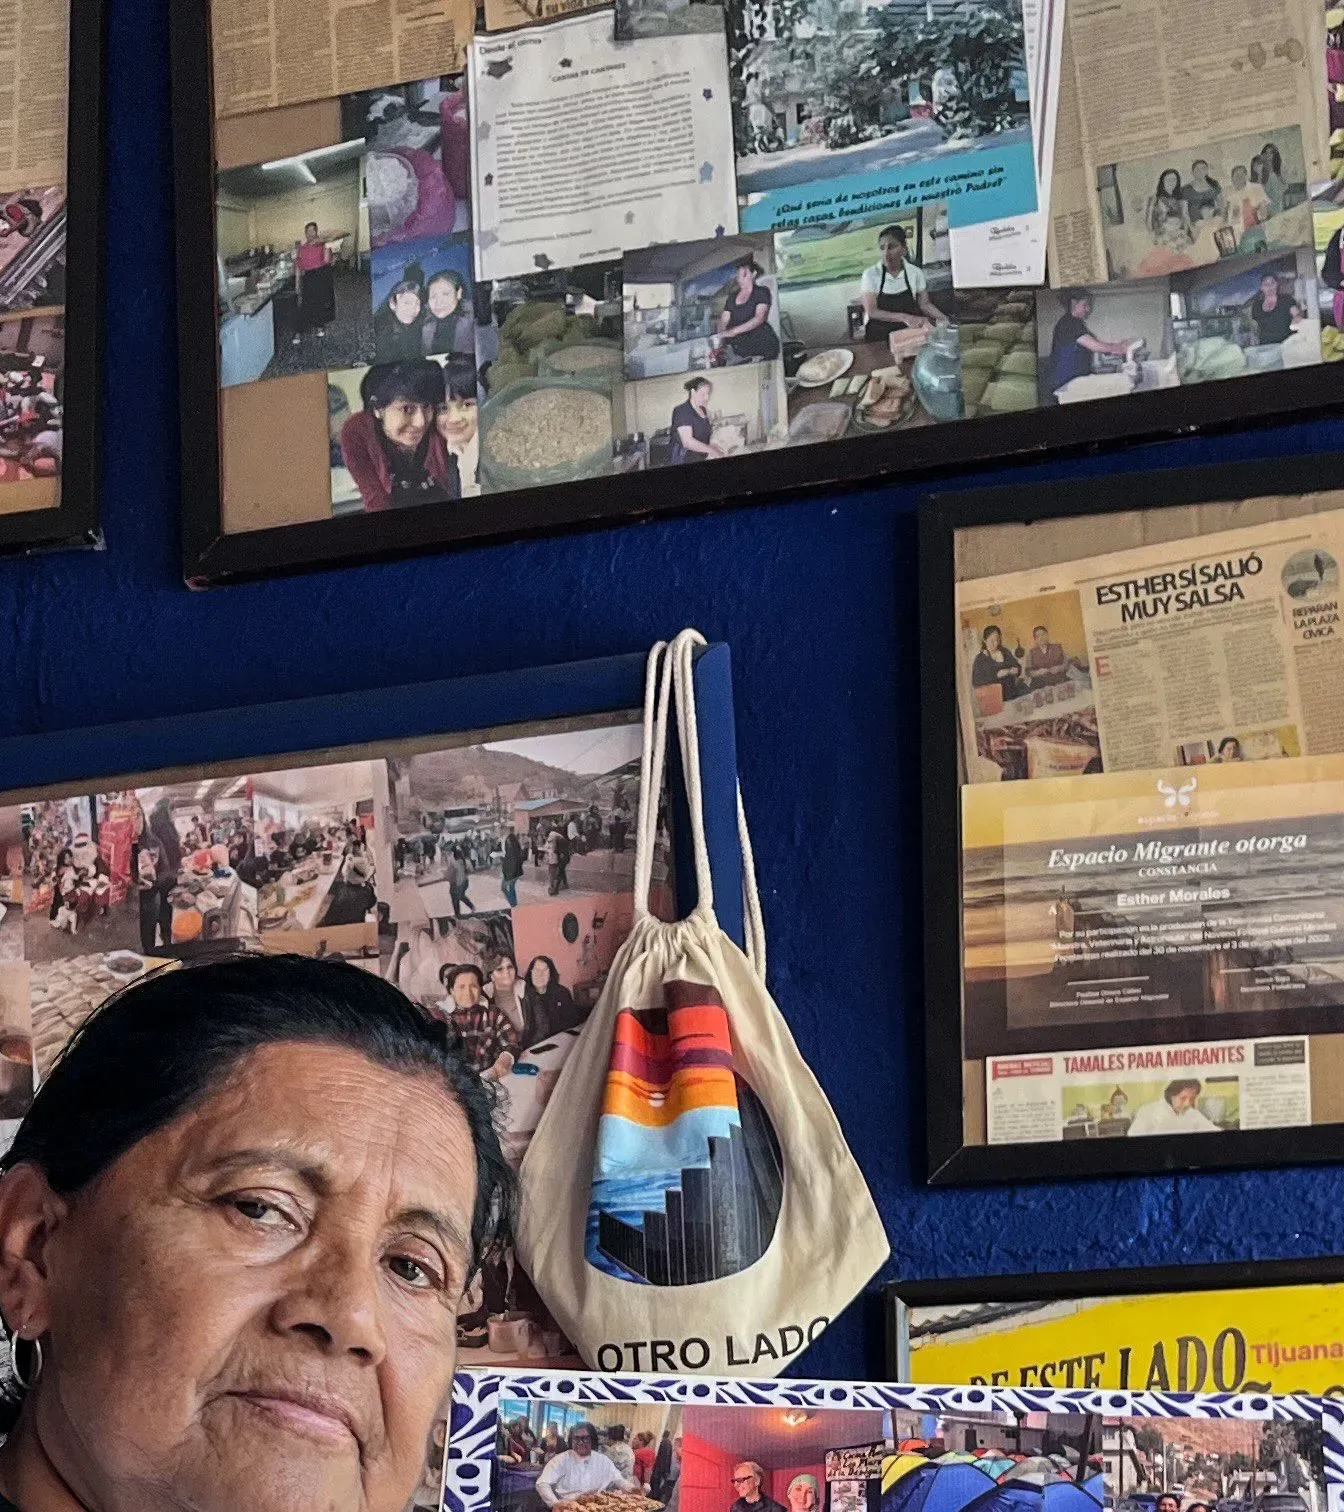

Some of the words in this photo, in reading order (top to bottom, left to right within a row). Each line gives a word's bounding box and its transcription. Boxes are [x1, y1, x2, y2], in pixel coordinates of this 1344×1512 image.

[836, 192, 849, 203] de
[944, 168, 984, 184] camino
[1096, 572, 1177, 606] ESTHER
[1177, 563, 1199, 588] SÍ
[1199, 551, 1264, 585] SALIÓ
[1120, 594, 1173, 624] MUY
[1175, 583, 1246, 613] SALSA
[1292, 601, 1339, 619] REPARAN
[1293, 616, 1307, 630] LA
[1047, 845, 1128, 871] Espacio
[1133, 838, 1231, 864] Migrante
[1235, 834, 1307, 855] otorga
[1138, 862, 1218, 878] CONSTANCIA
[1117, 891, 1164, 907] Esther
[1169, 886, 1231, 904] Morales
[1063, 1053, 1125, 1074] TAMALES
[1127, 1051, 1164, 1069] PARA
[1166, 1046, 1246, 1067] MIGRANTES
[597, 1337, 711, 1373] OTRO
[1119, 1327, 1246, 1393] LADO
[1251, 1340, 1344, 1368] Tijuana
